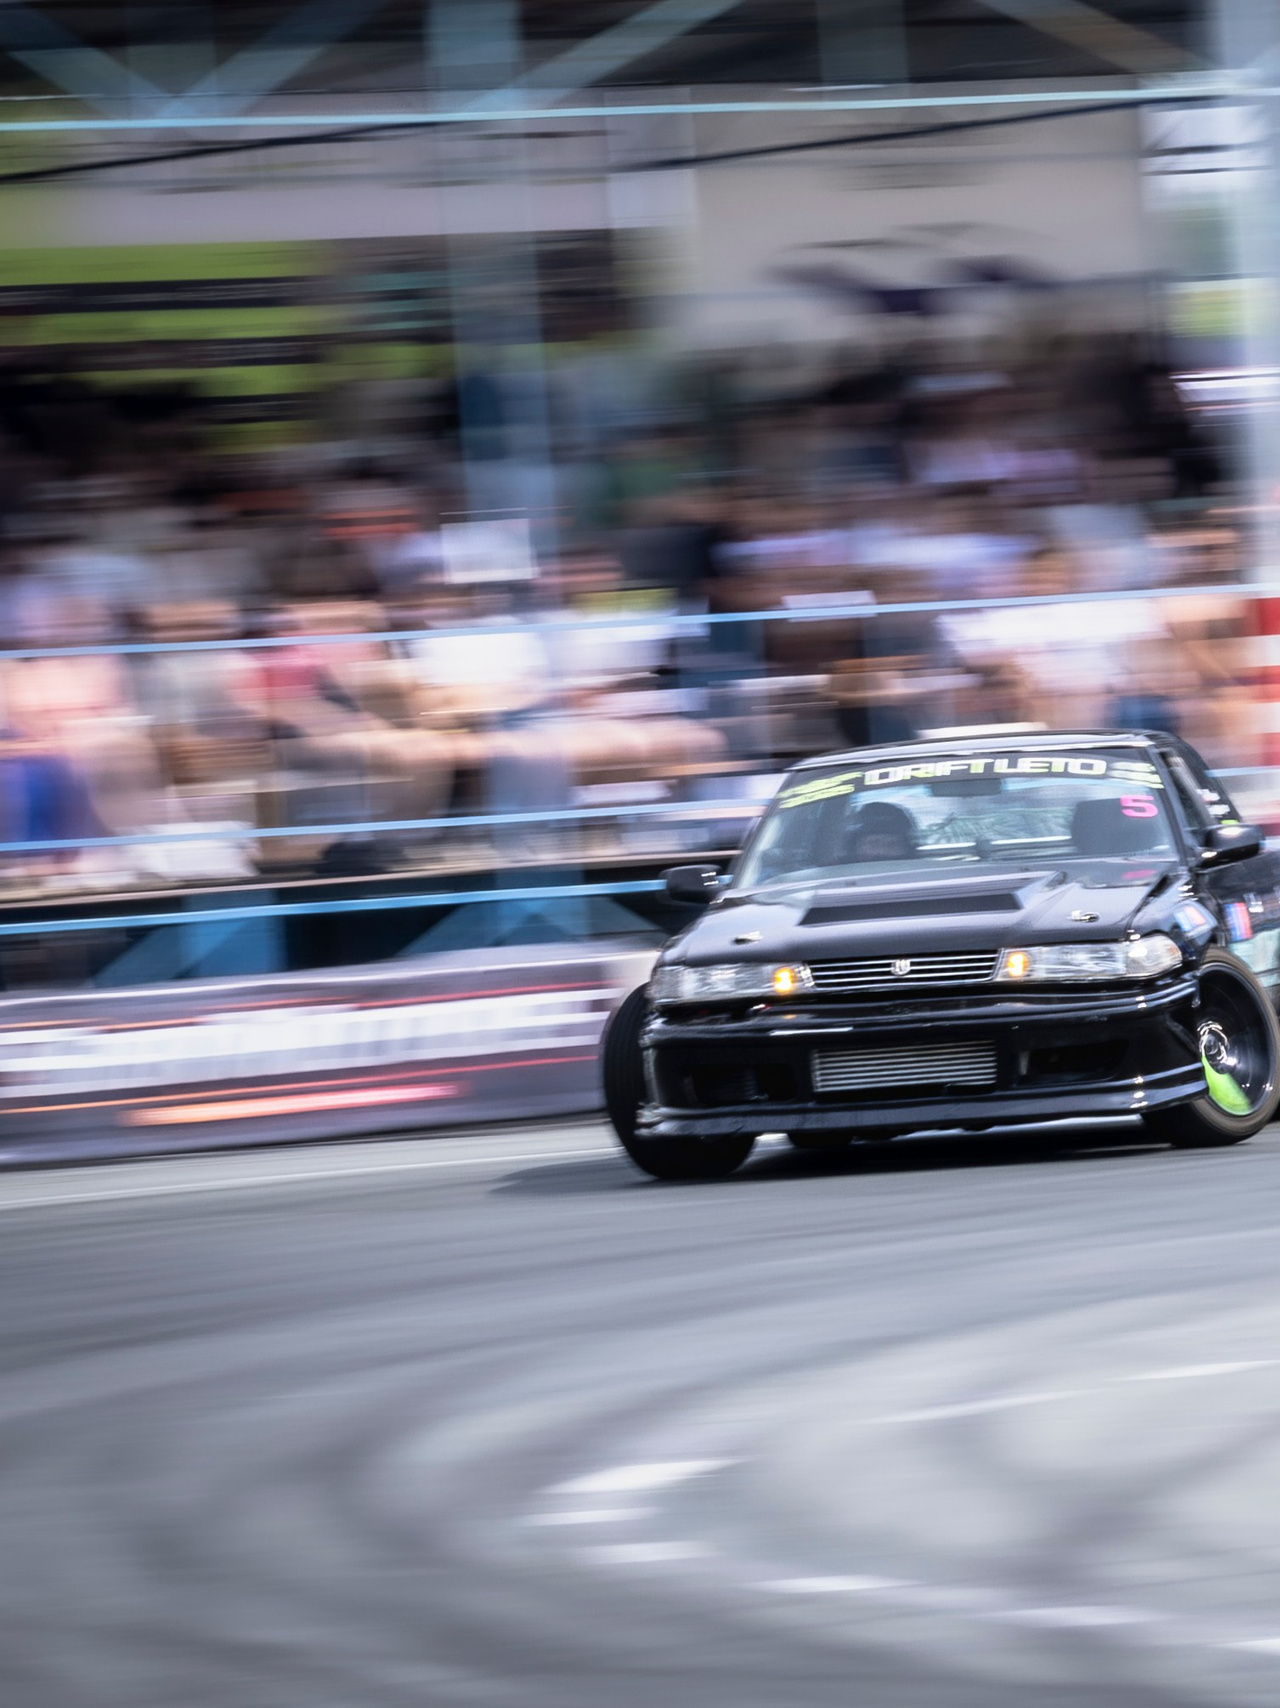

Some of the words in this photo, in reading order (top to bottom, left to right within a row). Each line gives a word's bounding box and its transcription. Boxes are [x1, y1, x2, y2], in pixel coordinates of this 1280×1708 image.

[864, 758, 995, 785] DRIFT
[994, 757, 1107, 775] LETO
[1120, 794, 1159, 818] 5
